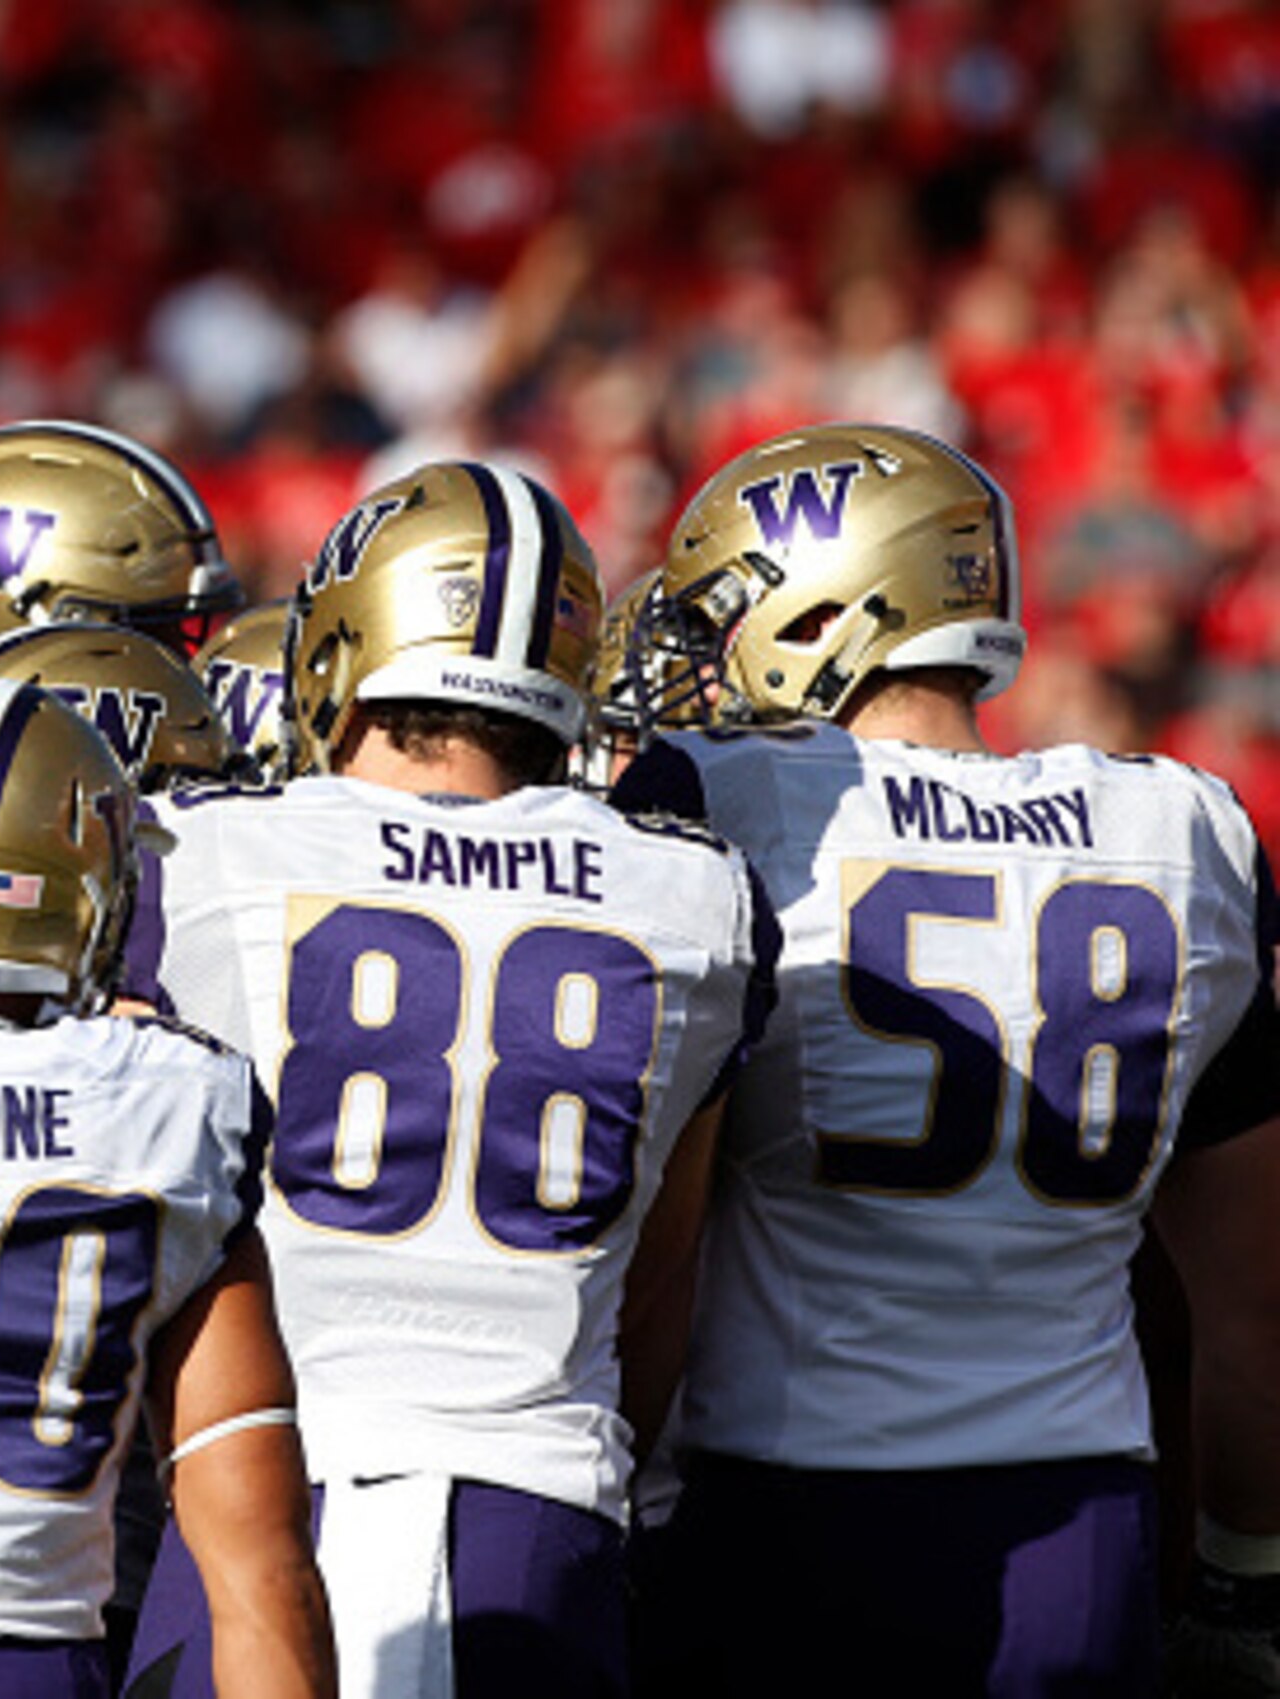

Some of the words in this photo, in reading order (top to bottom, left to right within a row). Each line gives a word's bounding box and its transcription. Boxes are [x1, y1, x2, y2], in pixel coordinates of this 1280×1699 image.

[303, 496, 408, 596] W
[736, 459, 864, 548] W
[206, 659, 285, 750] W
[883, 775, 1093, 848] MCGARY
[380, 821, 604, 902] SAMPLE
[264, 892, 664, 1259] 88
[813, 858, 1186, 1208] 58
